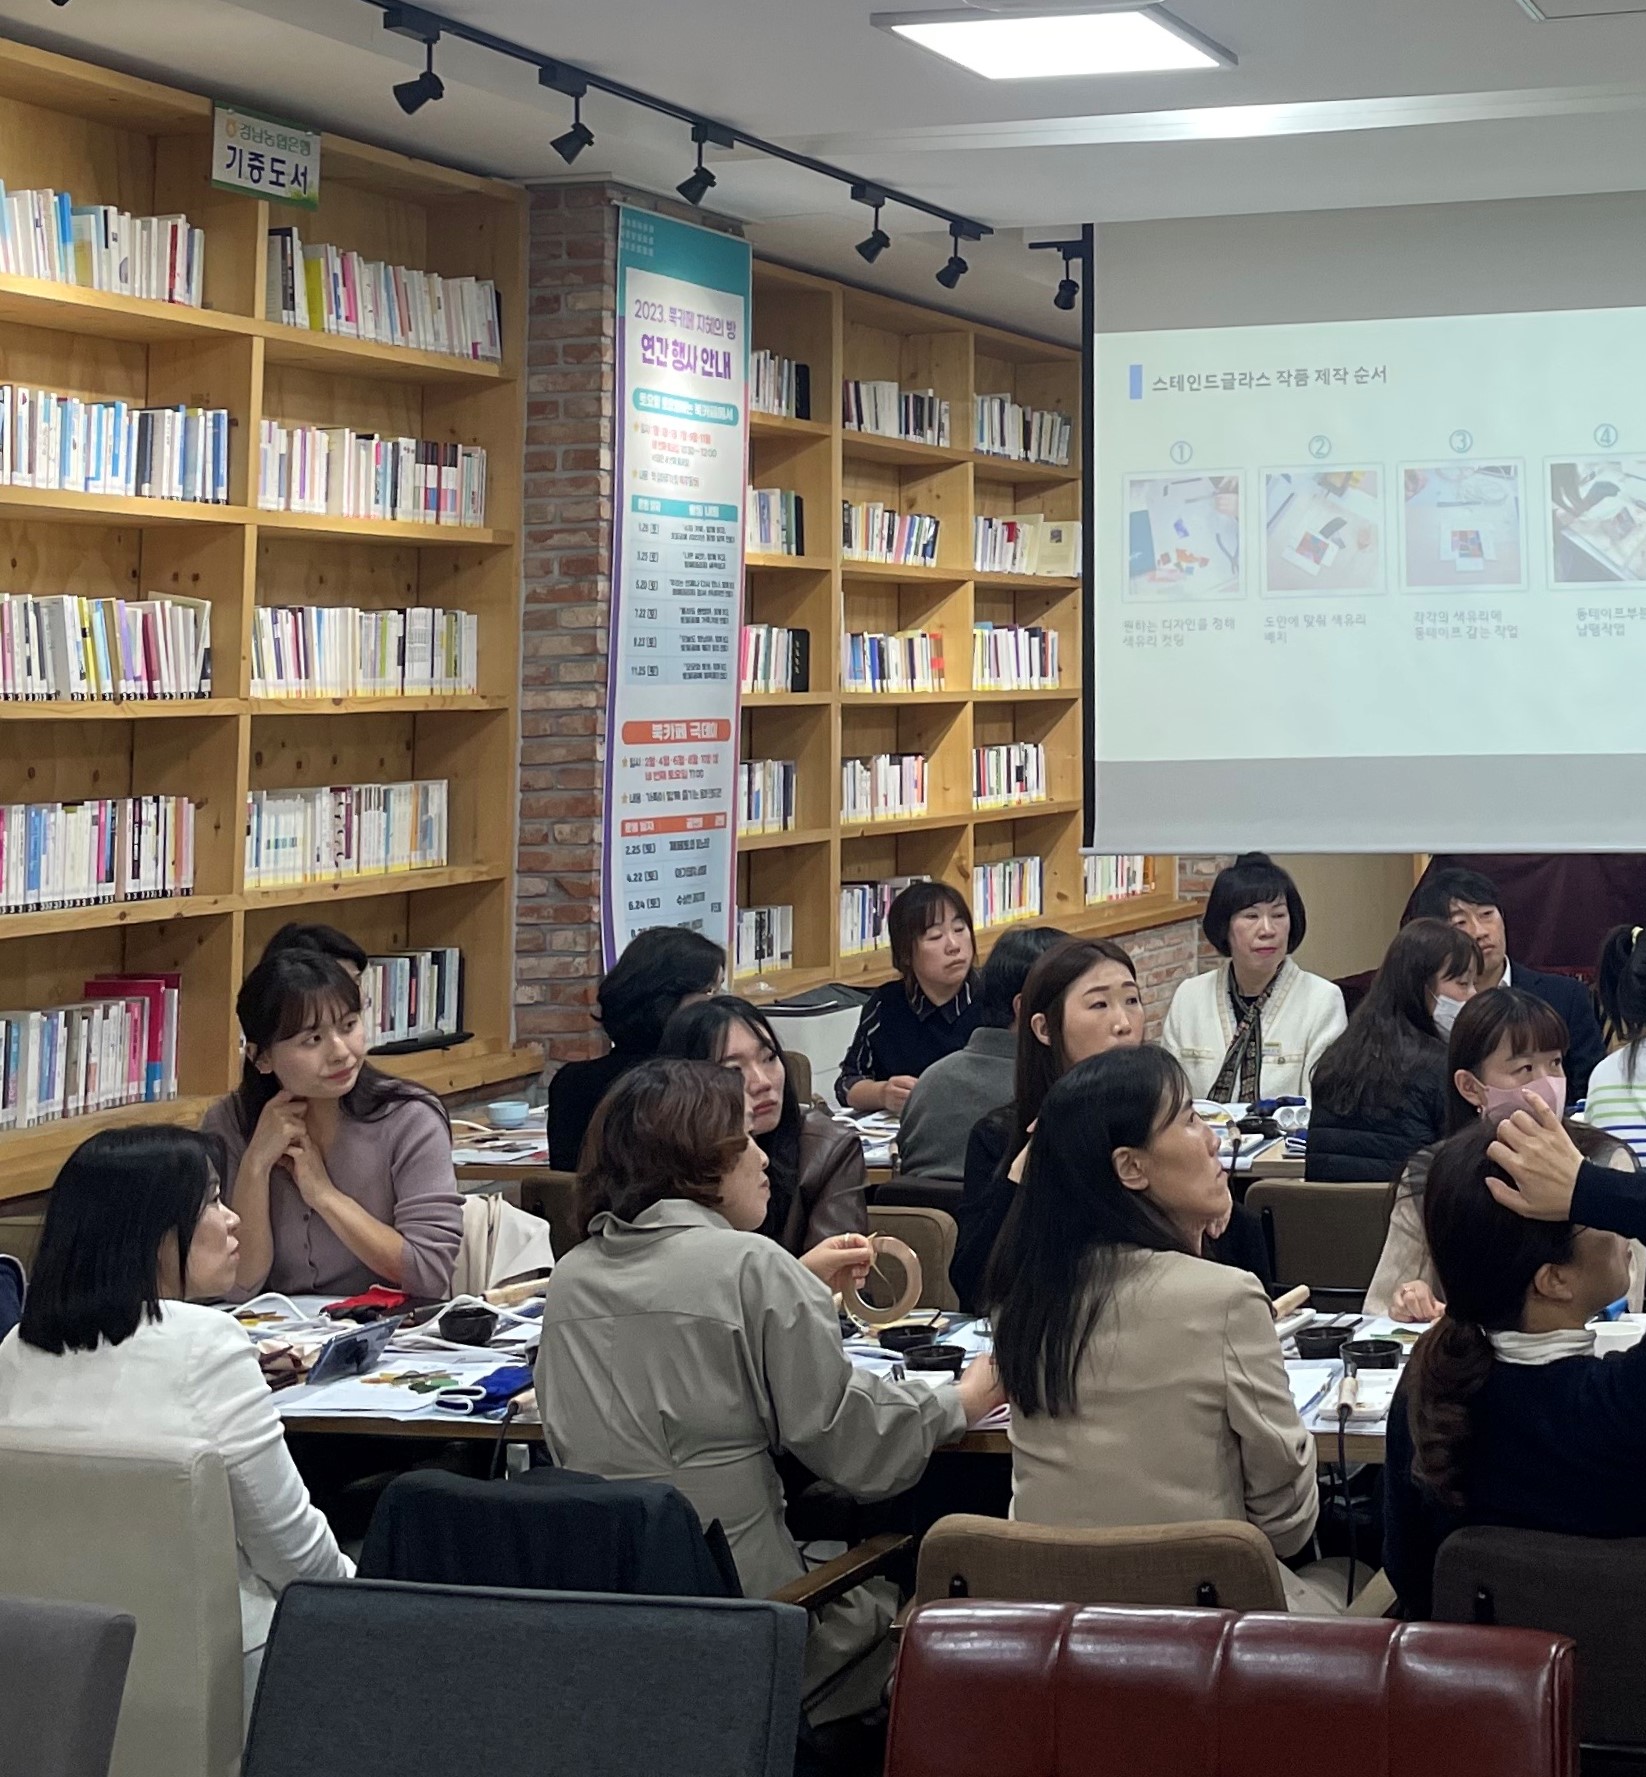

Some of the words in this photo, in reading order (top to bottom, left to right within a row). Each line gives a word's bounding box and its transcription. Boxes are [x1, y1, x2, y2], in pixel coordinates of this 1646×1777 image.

[226, 145, 308, 195] 기증도서
[634, 299, 667, 324] 2023.
[726, 319, 736, 340] 방
[641, 333, 669, 367] 연간
[672, 338, 697, 374] 행사
[701, 347, 731, 380] 안내
[1152, 371, 1272, 392] 스테인드글라스
[1276, 368, 1309, 387] 작품
[1315, 366, 1349, 386] 제작
[1354, 365, 1387, 384] 순서
[1162, 618, 1207, 631] 디자인을
[1264, 615, 1299, 629] 도안에
[1331, 613, 1367, 627] 색유리
[1414, 610, 1449, 624] 각각의
[1453, 610, 1502, 624] 색유리에
[1415, 626, 1463, 641] 동테이프
[1466, 625, 1491, 639] 감는
[1494, 624, 1518, 640] 작업
[1122, 635, 1157, 648] 색유리
